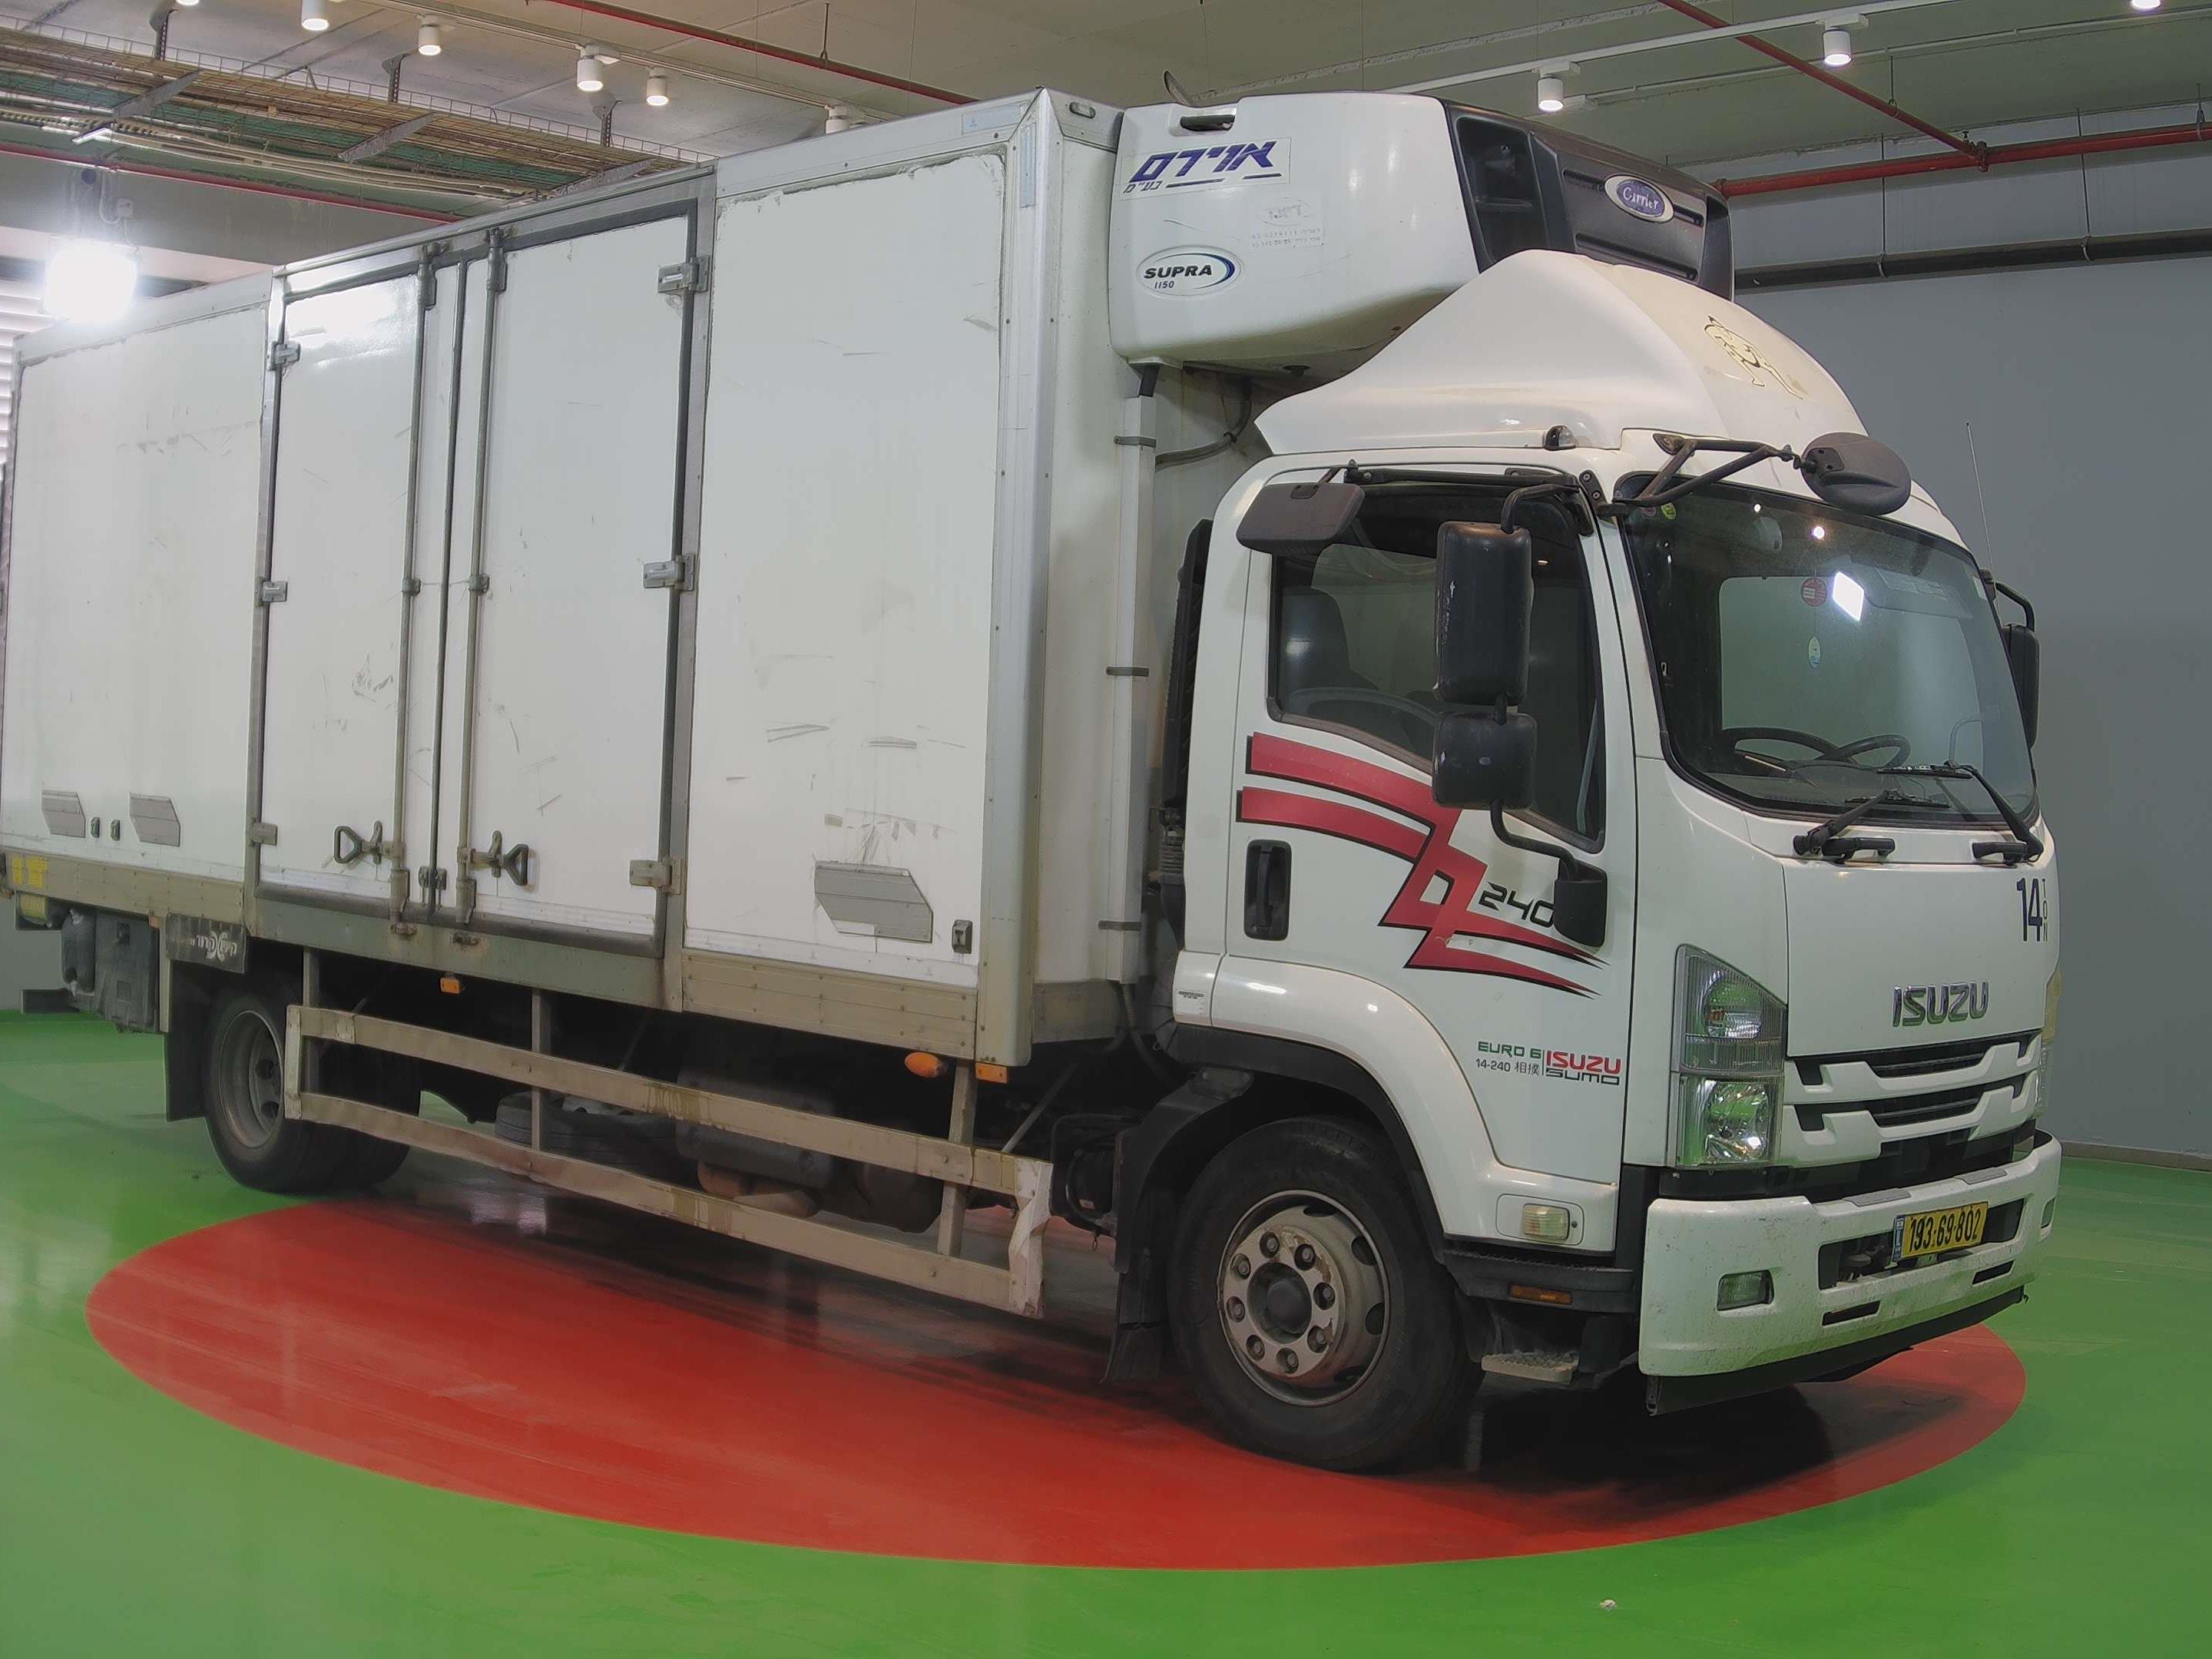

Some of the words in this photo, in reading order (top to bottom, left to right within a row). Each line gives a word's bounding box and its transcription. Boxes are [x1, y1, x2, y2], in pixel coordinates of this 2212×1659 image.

[1144, 265, 1212, 278] SUPRA
[1154, 280, 1174, 289] 1150
[1479, 882, 1555, 928] 240
[2017, 878, 2042, 942] 14
[1892, 982, 1989, 1027] ISUZU
[1478, 1041, 1525, 1058] EURO
[1530, 1048, 1541, 1059] 6
[1475, 1058, 1511, 1072] 14-240
[1546, 1050, 1621, 1075] ISUZU
[1545, 1068, 1620, 1086] SUMO
